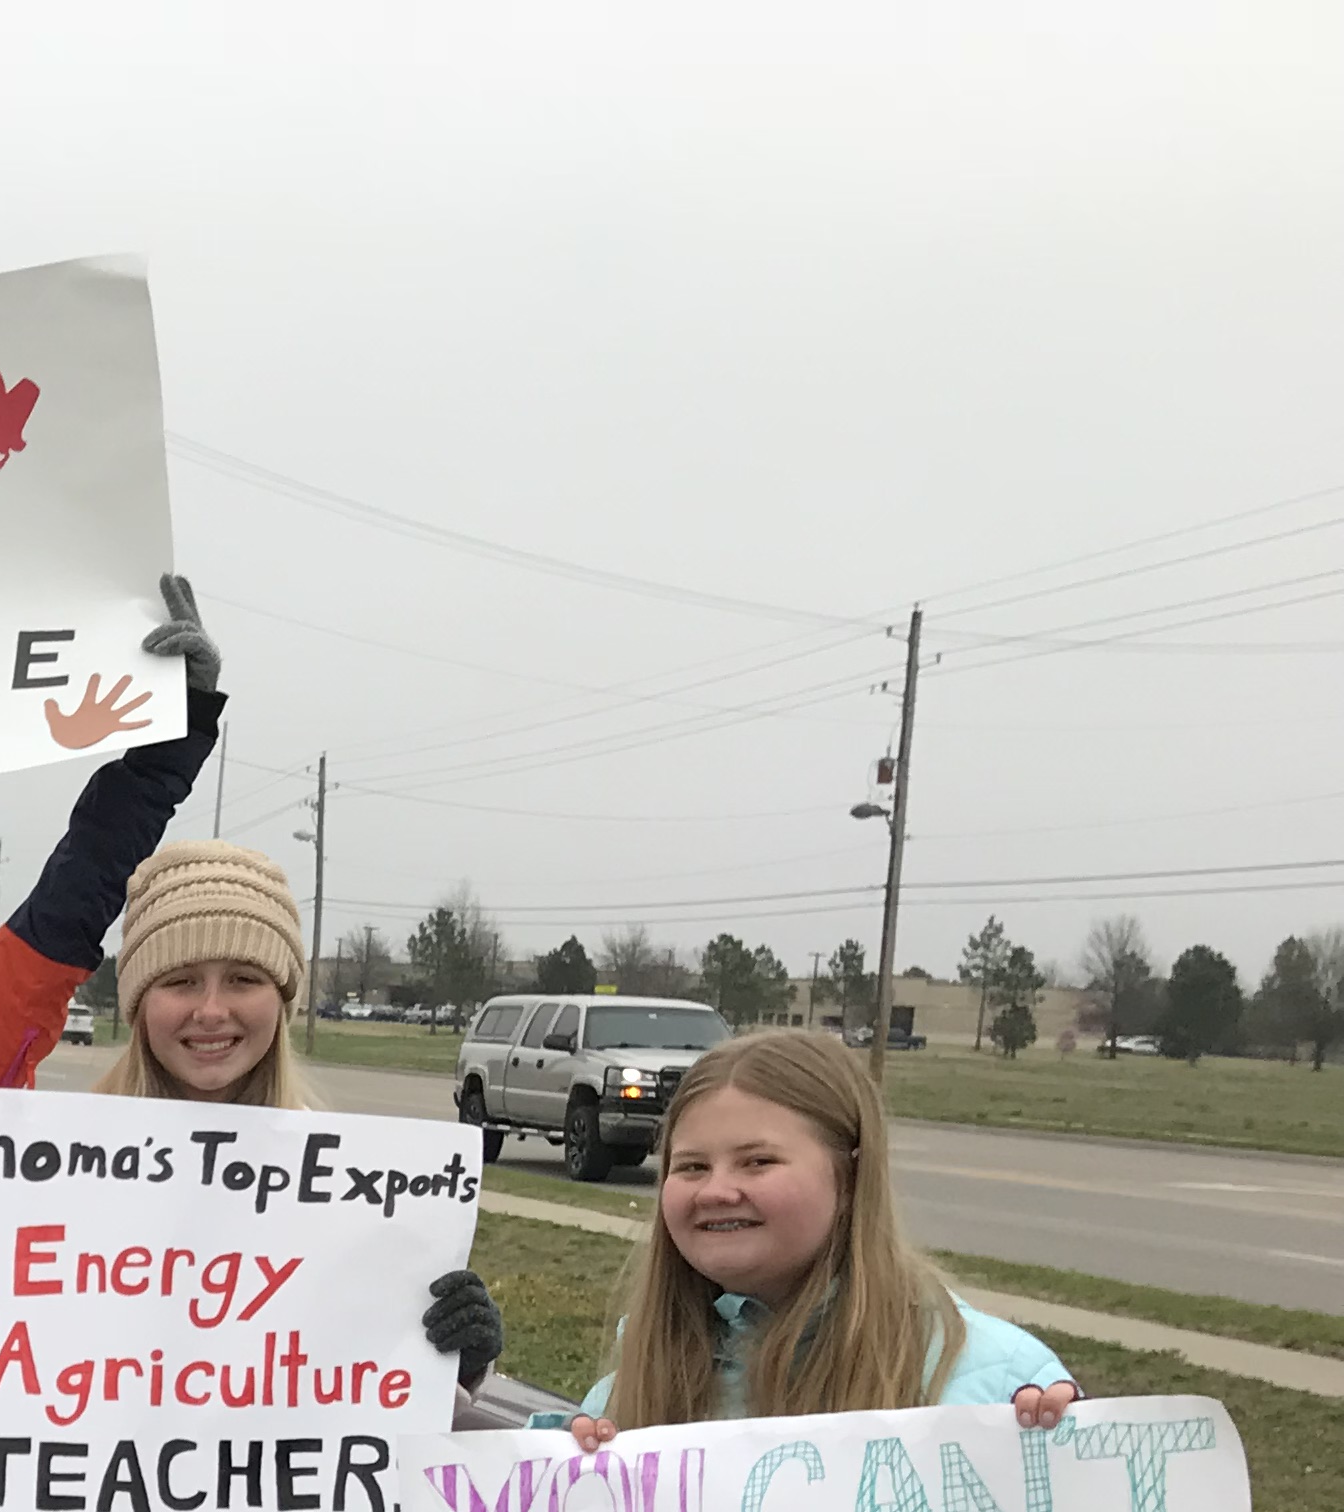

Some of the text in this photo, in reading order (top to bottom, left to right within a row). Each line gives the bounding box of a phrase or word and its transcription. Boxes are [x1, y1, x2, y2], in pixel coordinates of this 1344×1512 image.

[190, 1130, 290, 1214] Top
[297, 1133, 478, 1218] Exports
[12, 1224, 305, 1328] Energy
